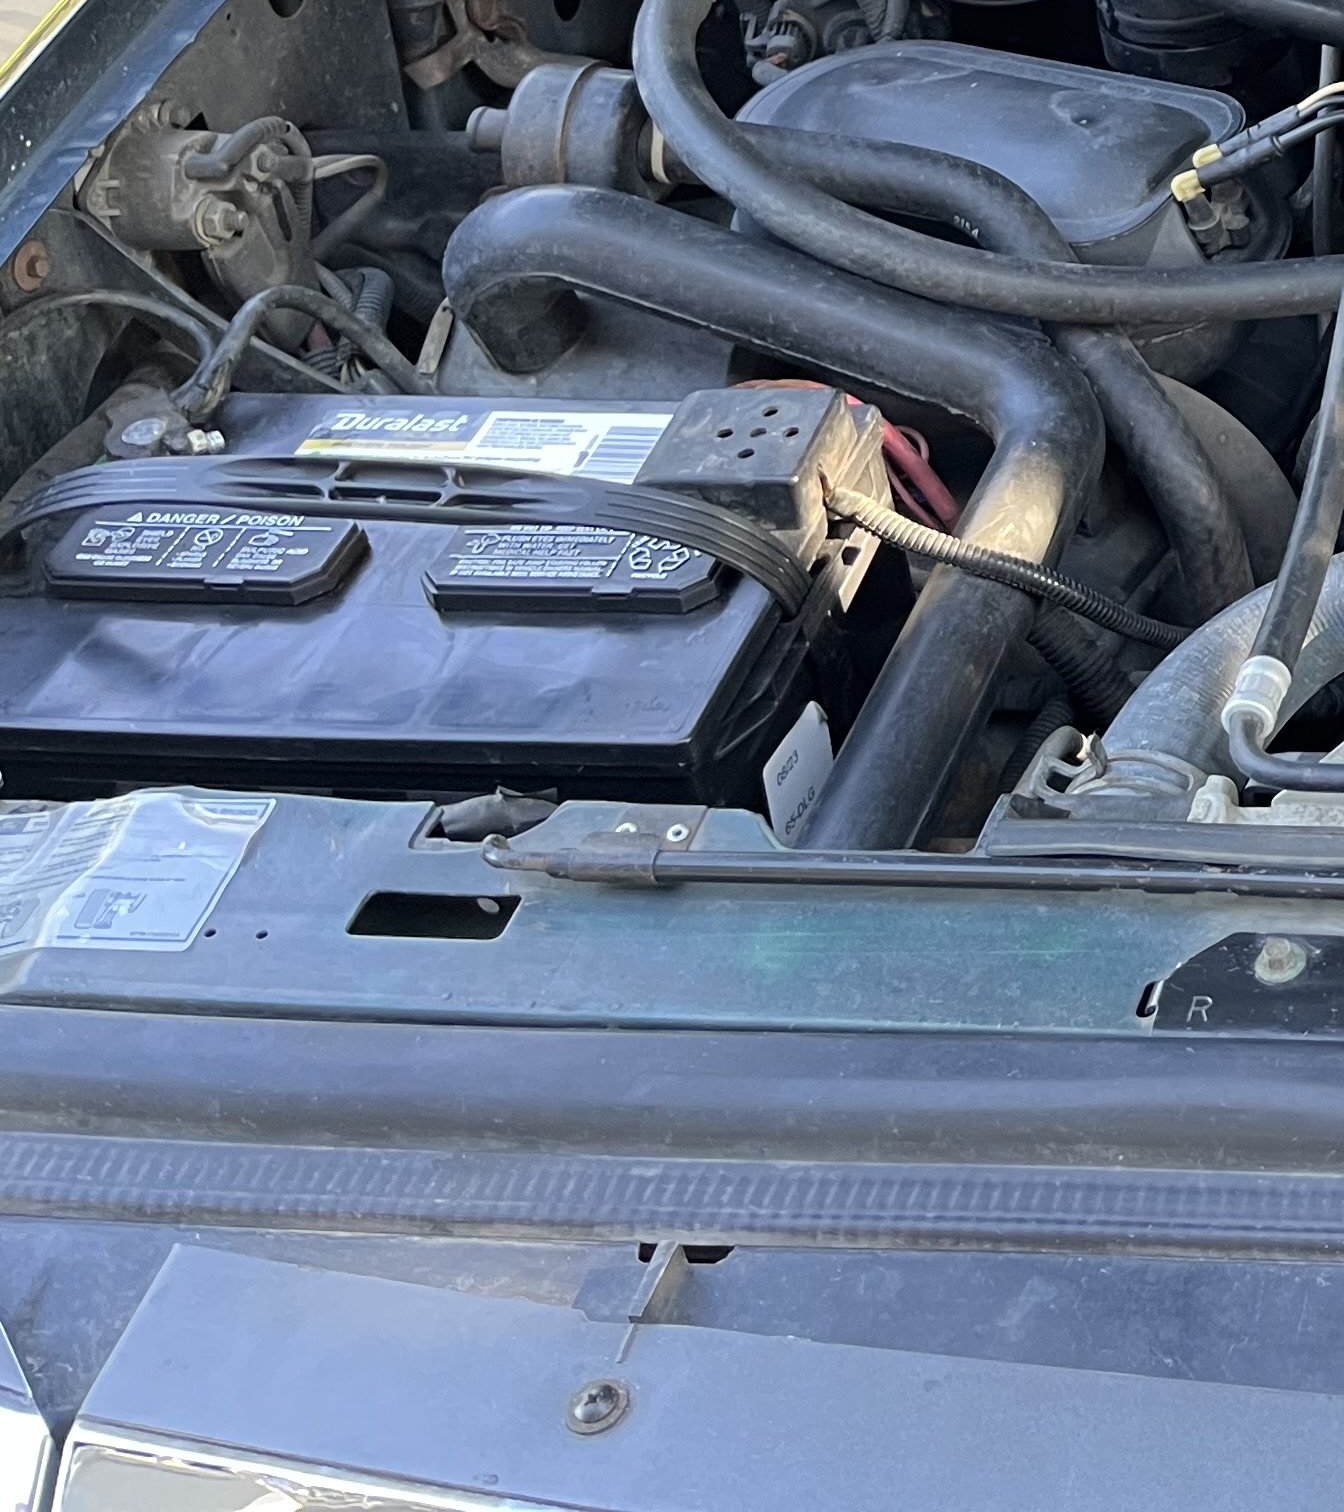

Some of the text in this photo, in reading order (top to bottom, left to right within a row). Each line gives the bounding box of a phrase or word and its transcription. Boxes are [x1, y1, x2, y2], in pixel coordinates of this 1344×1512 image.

[331, 413, 469, 432] Duralast
[146, 512, 221, 525] DANGER
[235, 515, 305, 527] POISON
[776, 749, 799, 786] 08/23
[785, 785, 816, 835] 65-DLG
[1186, 995, 1213, 1022] R
